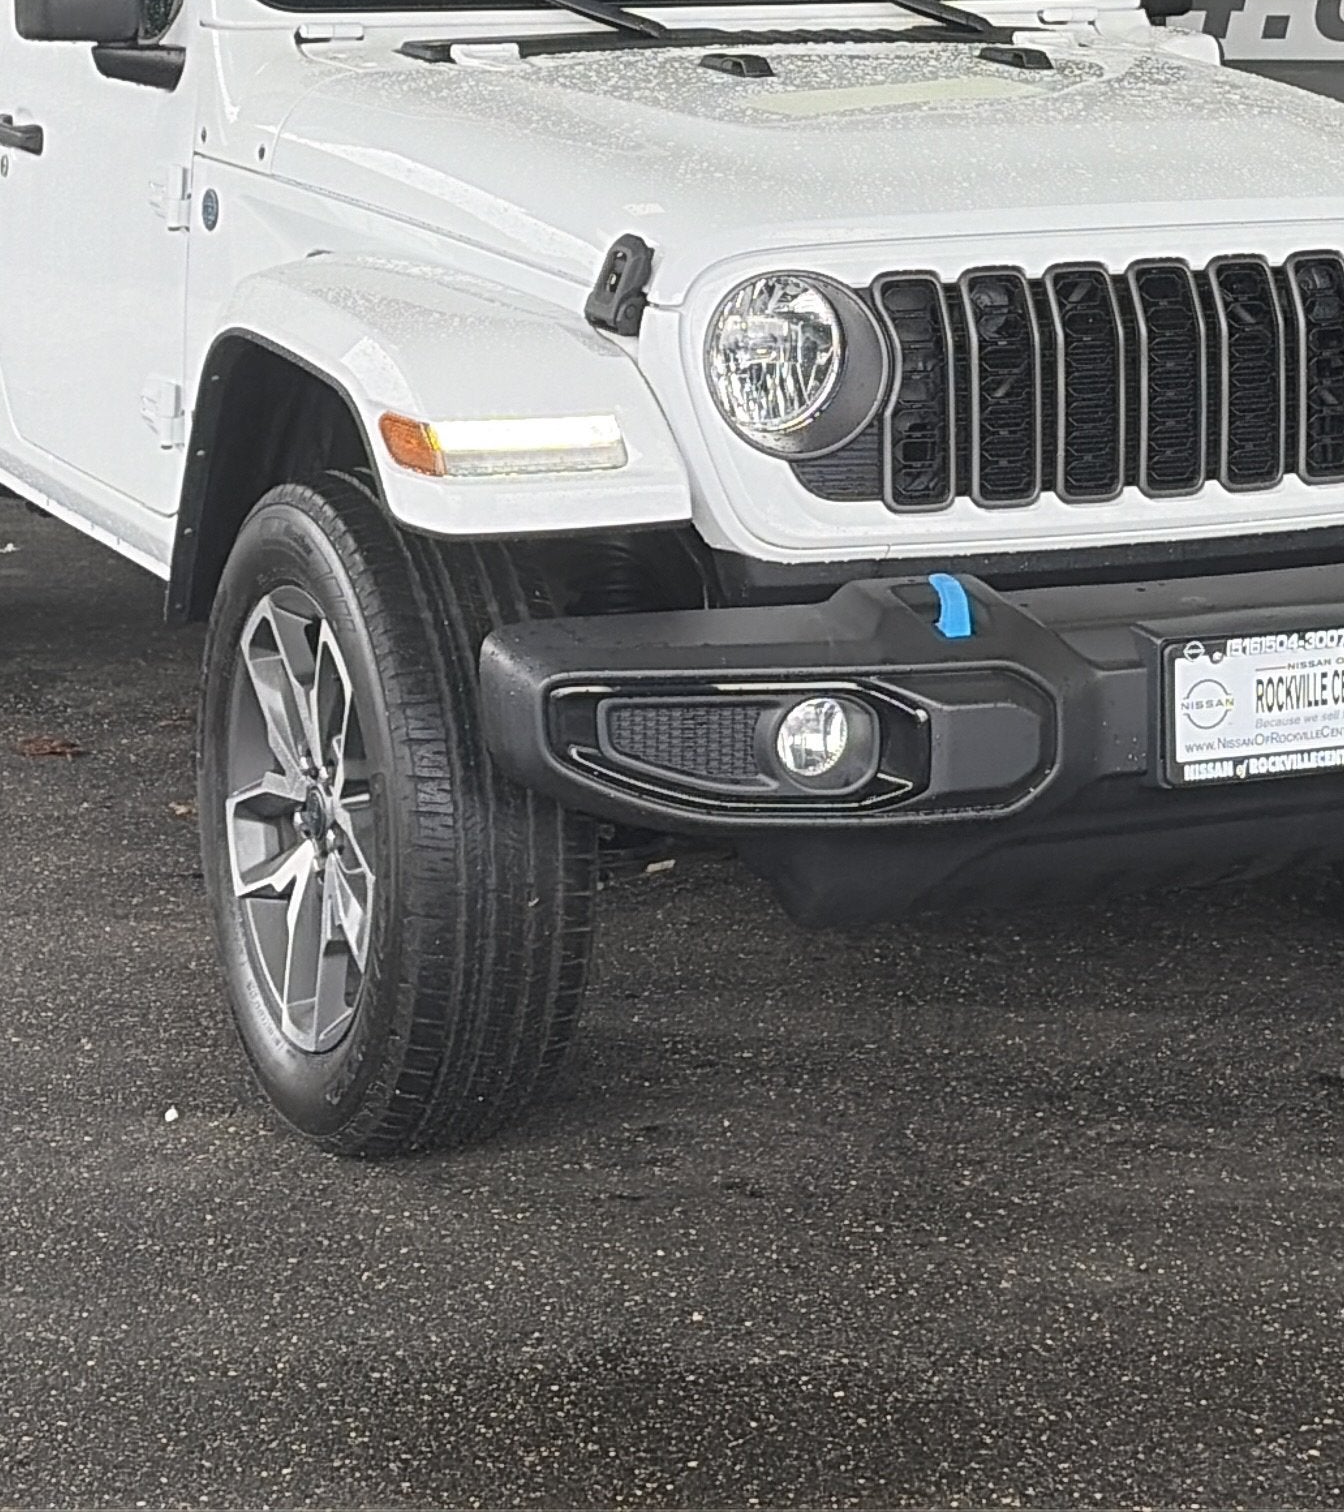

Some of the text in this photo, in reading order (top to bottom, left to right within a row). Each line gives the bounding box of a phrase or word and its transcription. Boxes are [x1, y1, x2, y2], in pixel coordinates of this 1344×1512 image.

[1287, 658, 1332, 670] NISSAN
[1256, 671, 1328, 714] ROCKVILLE
[1180, 697, 1234, 710] NISSAN
[1256, 714, 1302, 729] Because
[1304, 715, 1320, 724] we
[1322, 710, 1340, 721] sell
[1183, 759, 1234, 781] NISSAN
[1235, 759, 1248, 778] of
